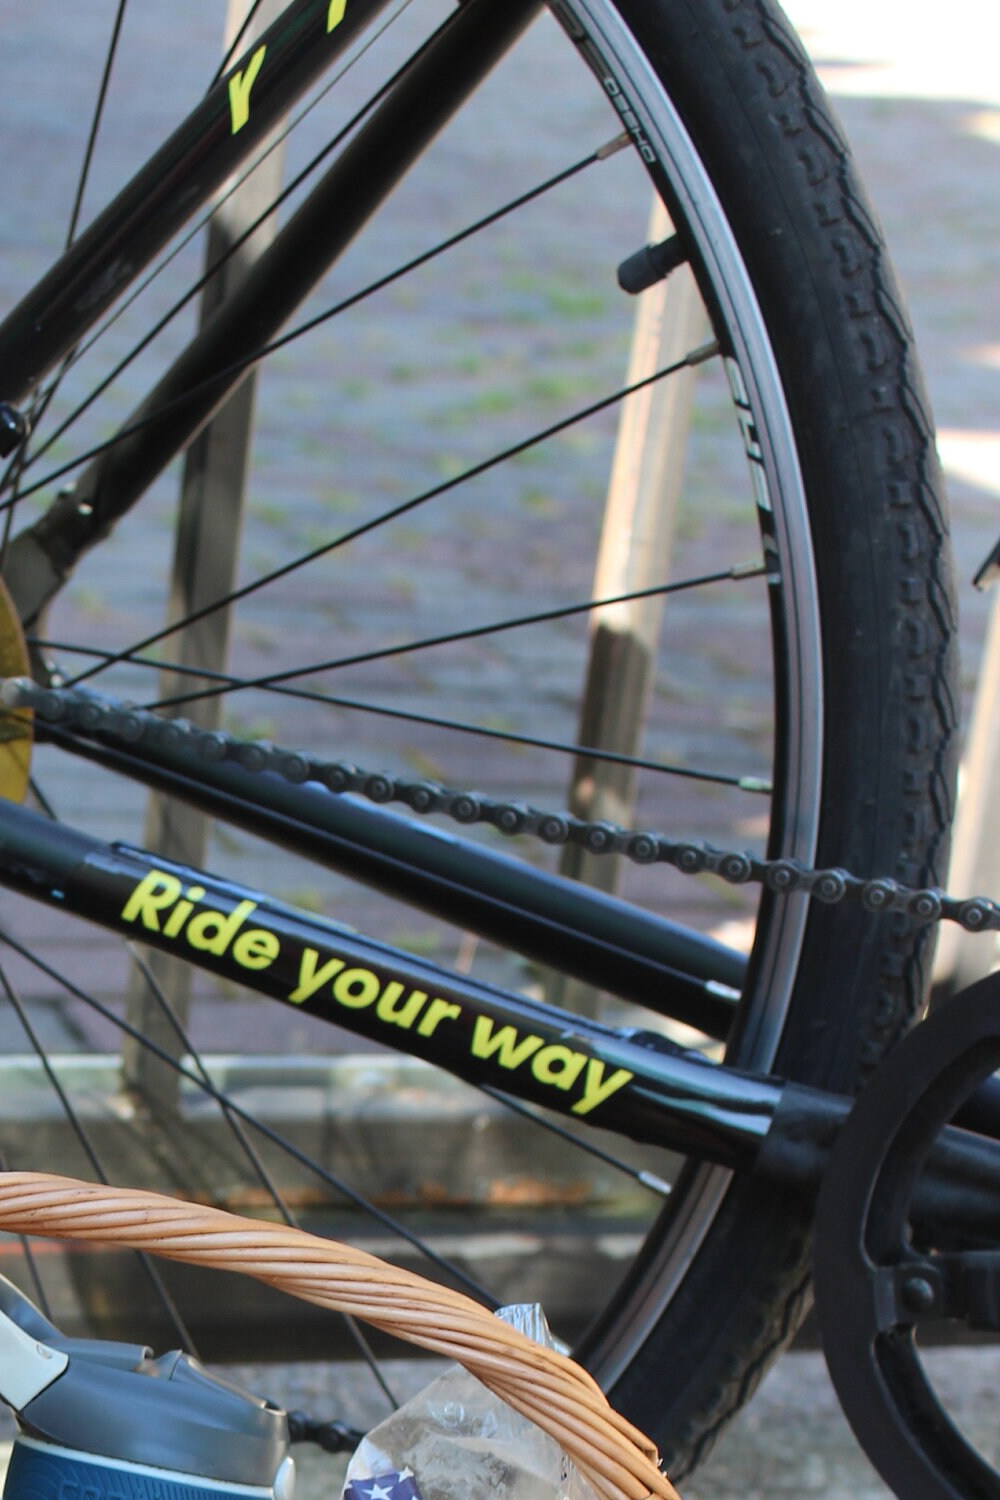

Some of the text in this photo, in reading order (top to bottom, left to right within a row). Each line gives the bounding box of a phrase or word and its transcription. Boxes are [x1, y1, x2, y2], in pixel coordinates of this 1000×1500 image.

[121, 870, 634, 1114] Ride your way
